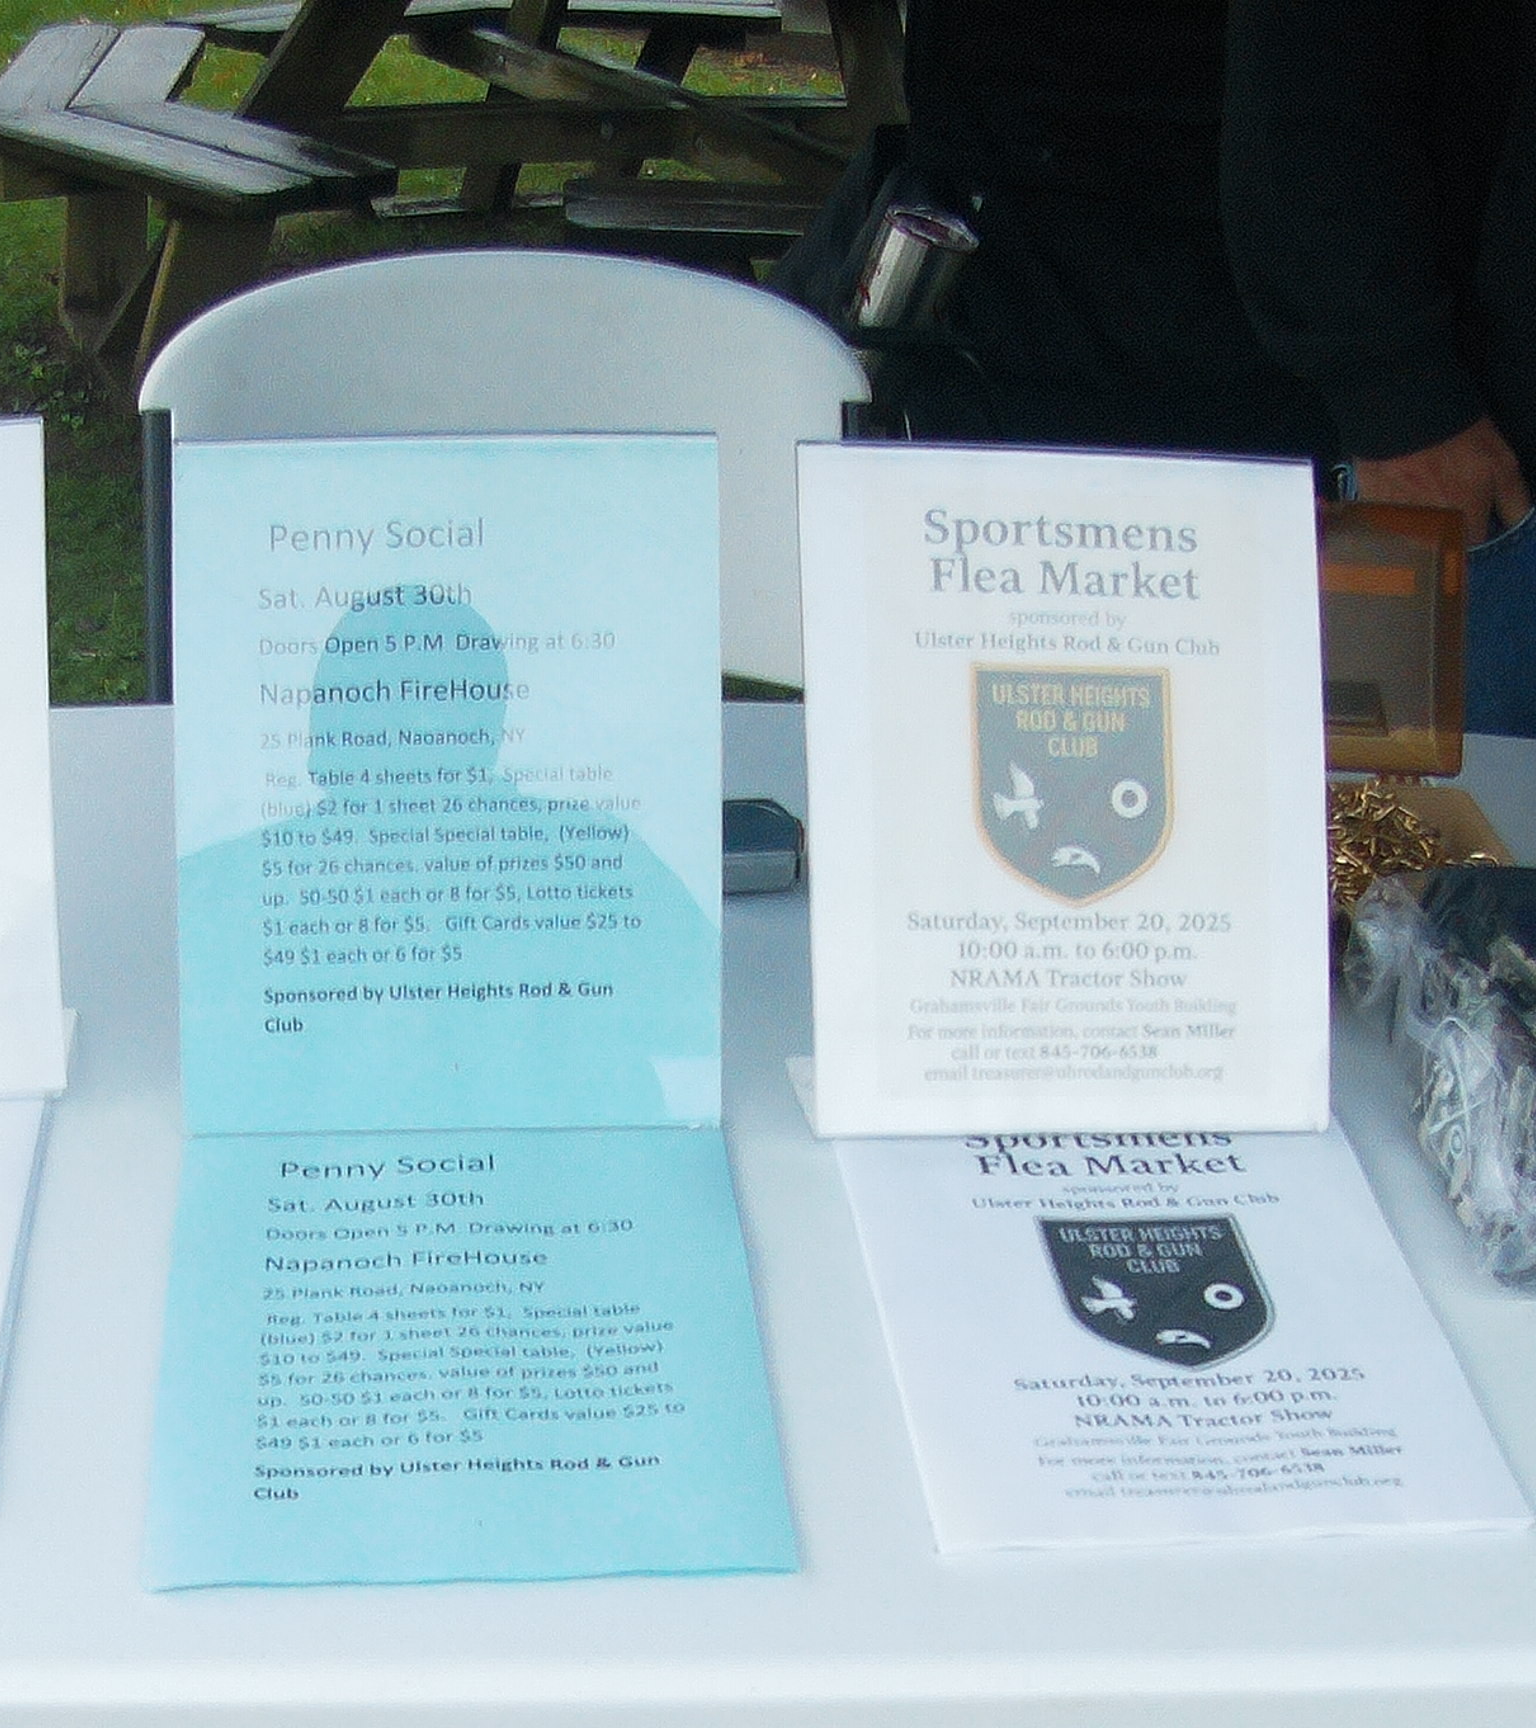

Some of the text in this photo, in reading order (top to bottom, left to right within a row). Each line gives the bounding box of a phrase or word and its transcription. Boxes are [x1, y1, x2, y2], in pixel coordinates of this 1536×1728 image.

[270, 517, 483, 556] Penny Social
[925, 509, 1197, 559] Sportsmens
[930, 555, 1199, 600] Flea Market
[316, 586, 405, 612] August
[414, 583, 470, 605] 30th
[1008, 610, 1127, 631] sponsored by
[259, 637, 318, 655] Doors
[325, 634, 378, 656] Open
[385, 634, 396, 652] 5
[456, 633, 538, 652] Drawing
[546, 631, 564, 649] at
[915, 631, 1220, 655] Ulster Heights Rod & Gun Club
[261, 679, 528, 706] Napanoch FireHouse
[992, 683, 1151, 708] ULSTER HEIGHTS
[1015, 708, 1127, 733] ROD & GUN
[261, 731, 281, 749] 25
[288, 731, 336, 748] Plank
[502, 727, 526, 745] NY
[1048, 737, 1099, 759] CLUB
[1015, 911, 1129, 935] September
[1179, 912, 1231, 932] 2025
[959, 940, 1018, 959] 10:00
[1076, 943, 1096, 959] to
[1102, 941, 1150, 959] 6:00
[951, 968, 1187, 988] NRAMA Tractor Show
[264, 981, 613, 1006] Sponsored by Ulster Heights Rod & Gun
[265, 1017, 303, 1033] Club
[281, 1153, 494, 1180] Penny Social
[976, 1153, 1244, 1177] Flea Market
[325, 1195, 415, 1213] August
[426, 1190, 484, 1207] 30th
[265, 1250, 547, 1274] Napanoch FireHouse
[1131, 1373, 1253, 1390] September
[1308, 1368, 1365, 1381] 2025
